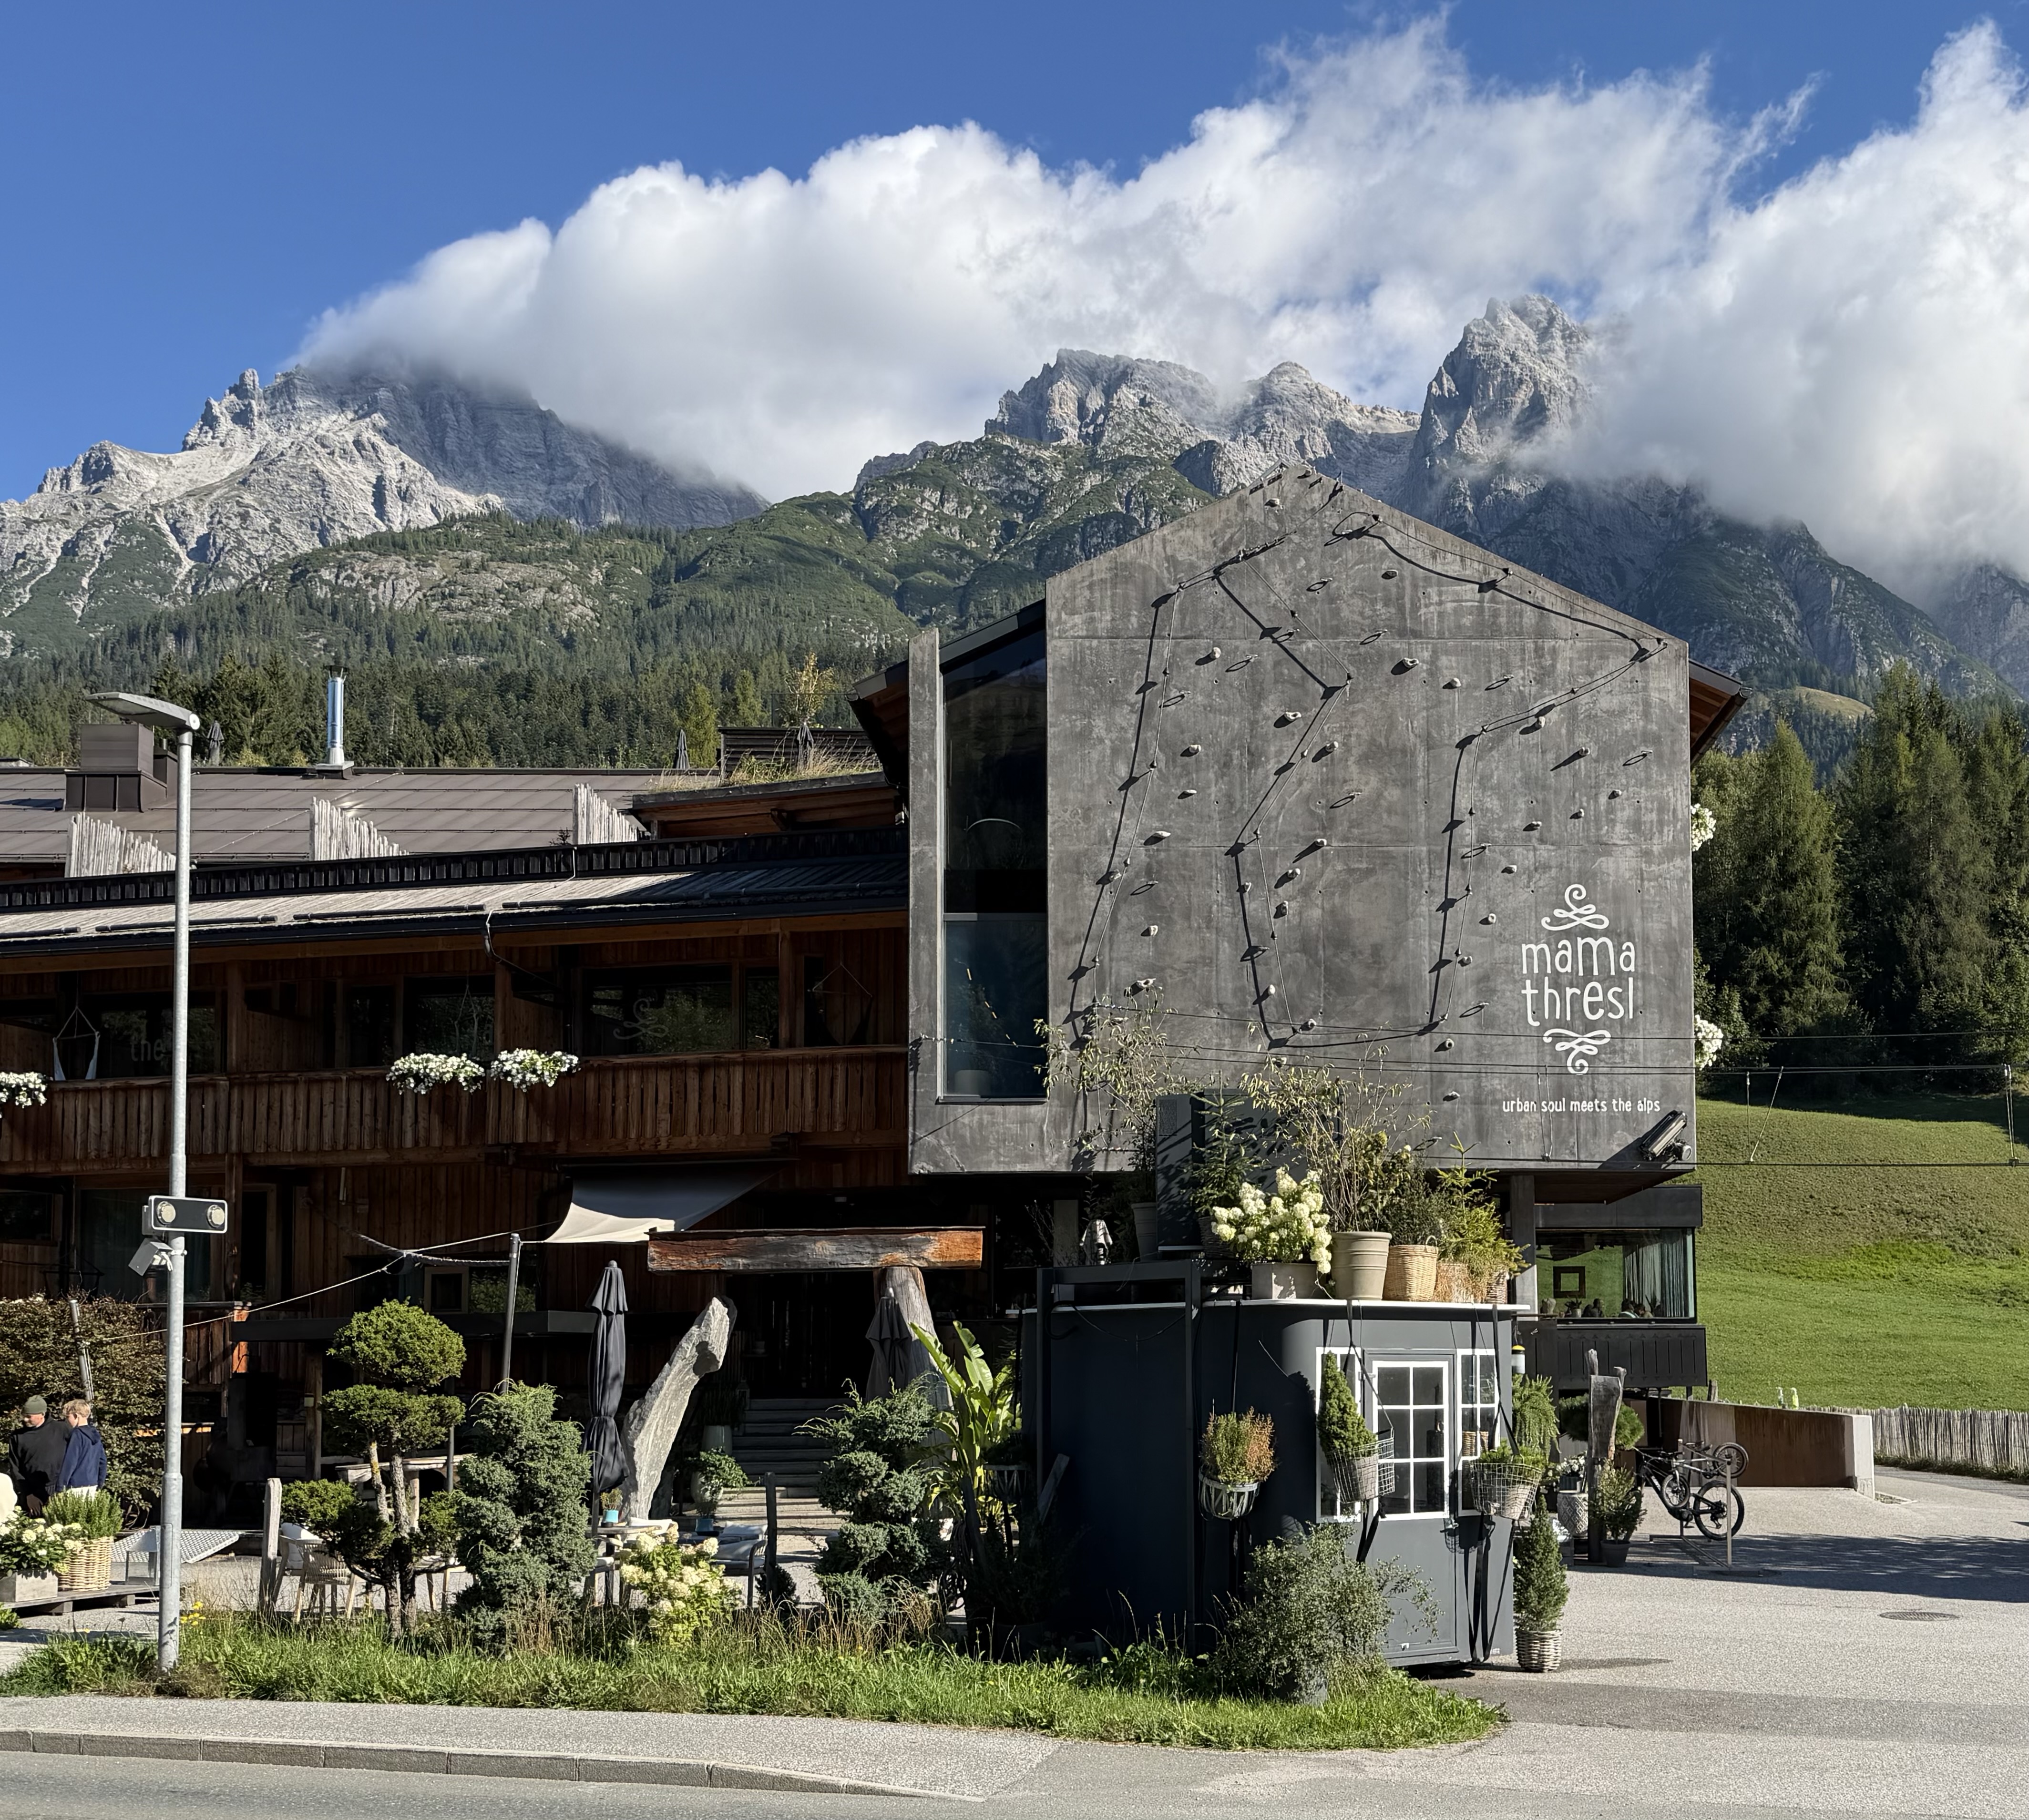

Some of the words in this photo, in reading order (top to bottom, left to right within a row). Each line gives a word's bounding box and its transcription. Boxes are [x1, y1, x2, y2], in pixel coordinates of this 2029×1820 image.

[1521, 936, 1636, 976] mama
[1521, 976, 1634, 1027] thresl
[1502, 1097, 1537, 1112] urban
[1541, 1097, 1566, 1113] soul
[1570, 1098, 1608, 1112] meets
[1611, 1097, 1632, 1112] the
[1637, 1097, 1660, 1114] alps
